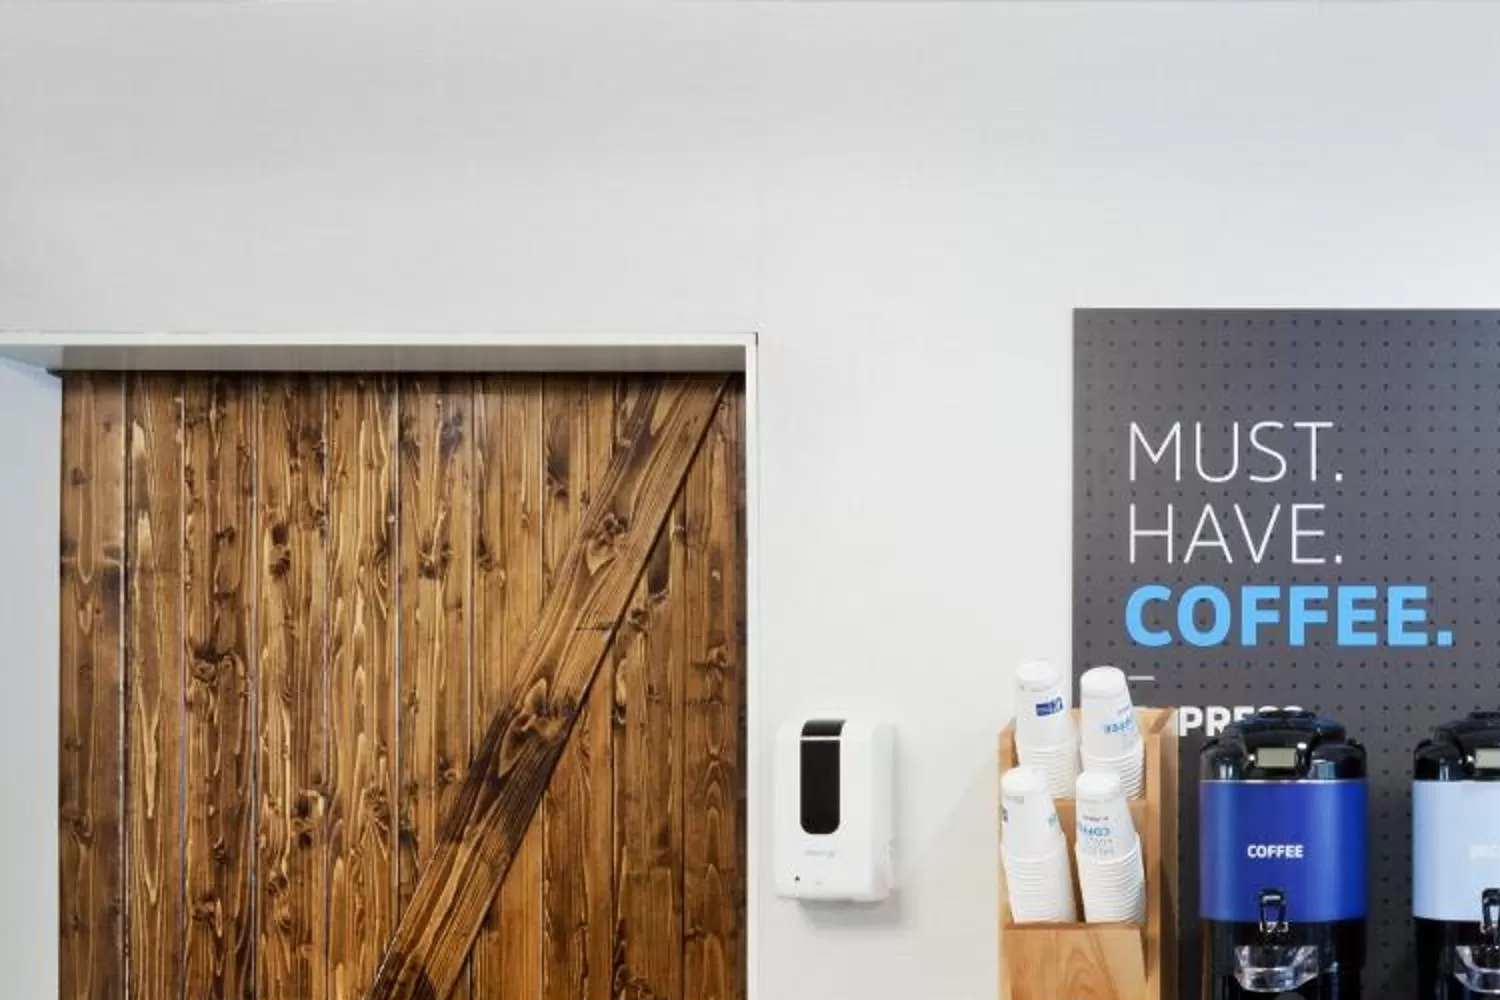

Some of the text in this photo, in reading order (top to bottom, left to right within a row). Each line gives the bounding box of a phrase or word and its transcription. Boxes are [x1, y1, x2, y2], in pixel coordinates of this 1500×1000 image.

[1129, 421, 1344, 483] MUST.
[1129, 503, 1343, 565] HAVE.
[1125, 584, 1453, 647] COFFEE.
[1247, 844, 1304, 859] COFFEE
